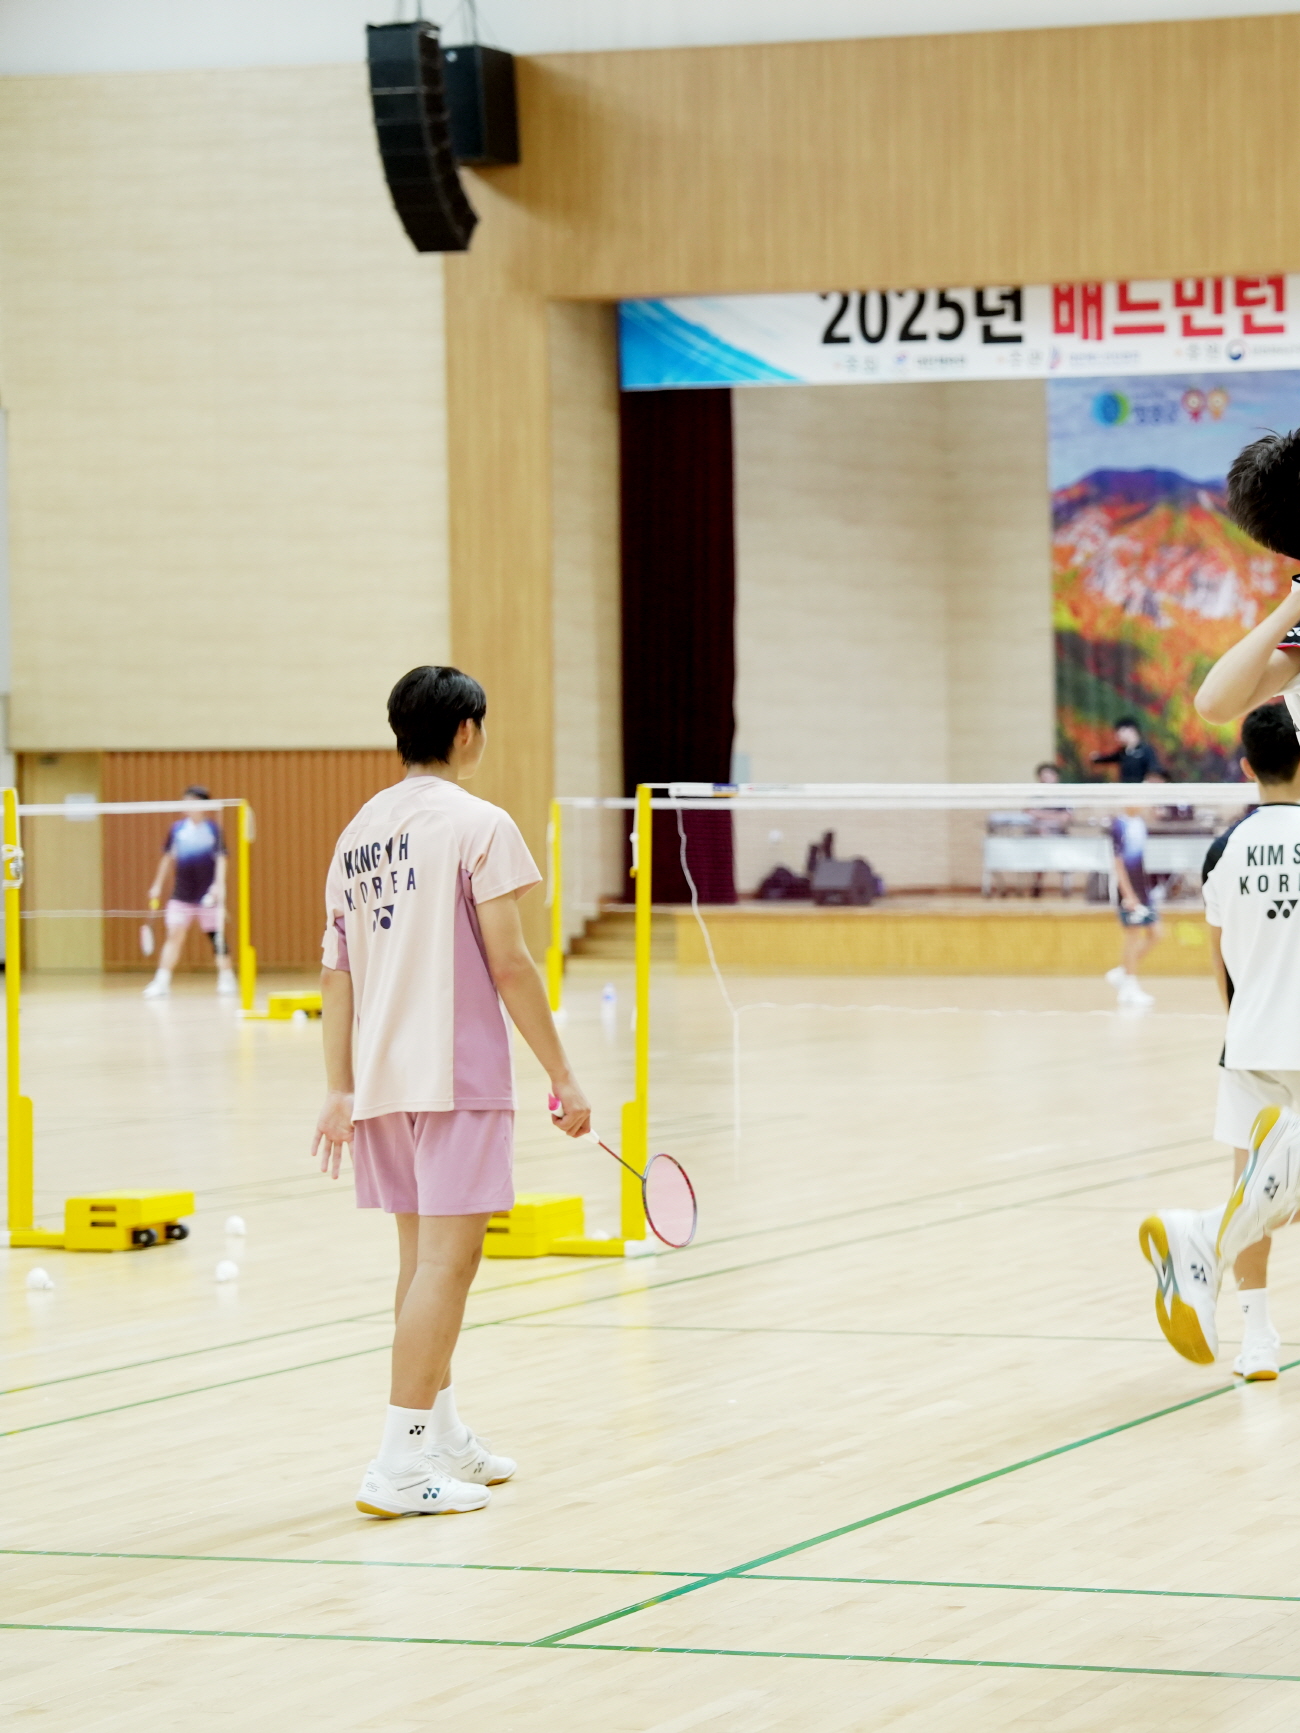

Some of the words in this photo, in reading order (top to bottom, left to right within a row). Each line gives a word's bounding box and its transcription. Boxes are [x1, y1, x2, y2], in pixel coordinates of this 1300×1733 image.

[821, 286, 1023, 344] 2025년
[1246, 844, 1284, 867] KIM
[344, 867, 417, 912] KOREA
